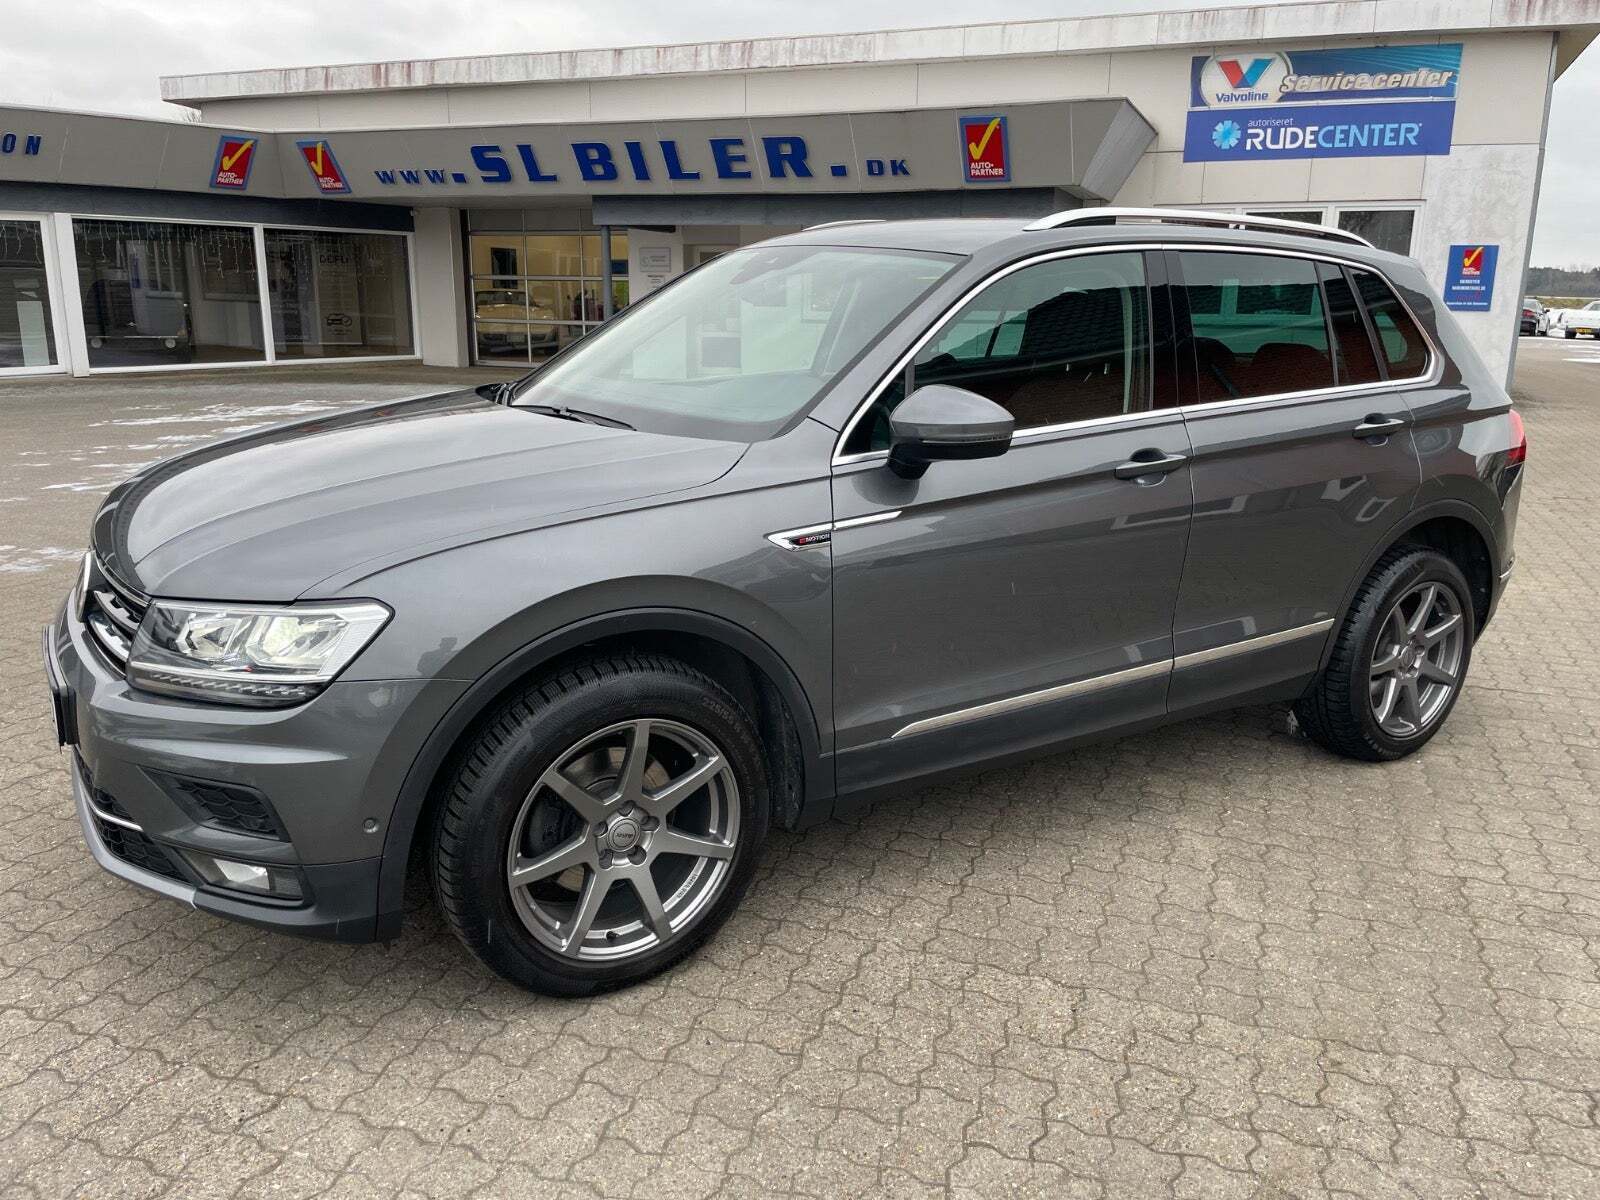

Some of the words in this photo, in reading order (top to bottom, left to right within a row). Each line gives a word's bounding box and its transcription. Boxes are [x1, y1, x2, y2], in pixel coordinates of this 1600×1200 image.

[1216, 91, 1269, 102] Valvoline
[1247, 117, 1294, 126] autoriseret
[1245, 123, 1419, 150] RUDECENTER
[971, 168, 1004, 176] PARTNER
[216, 177, 243, 185] PARTNER
